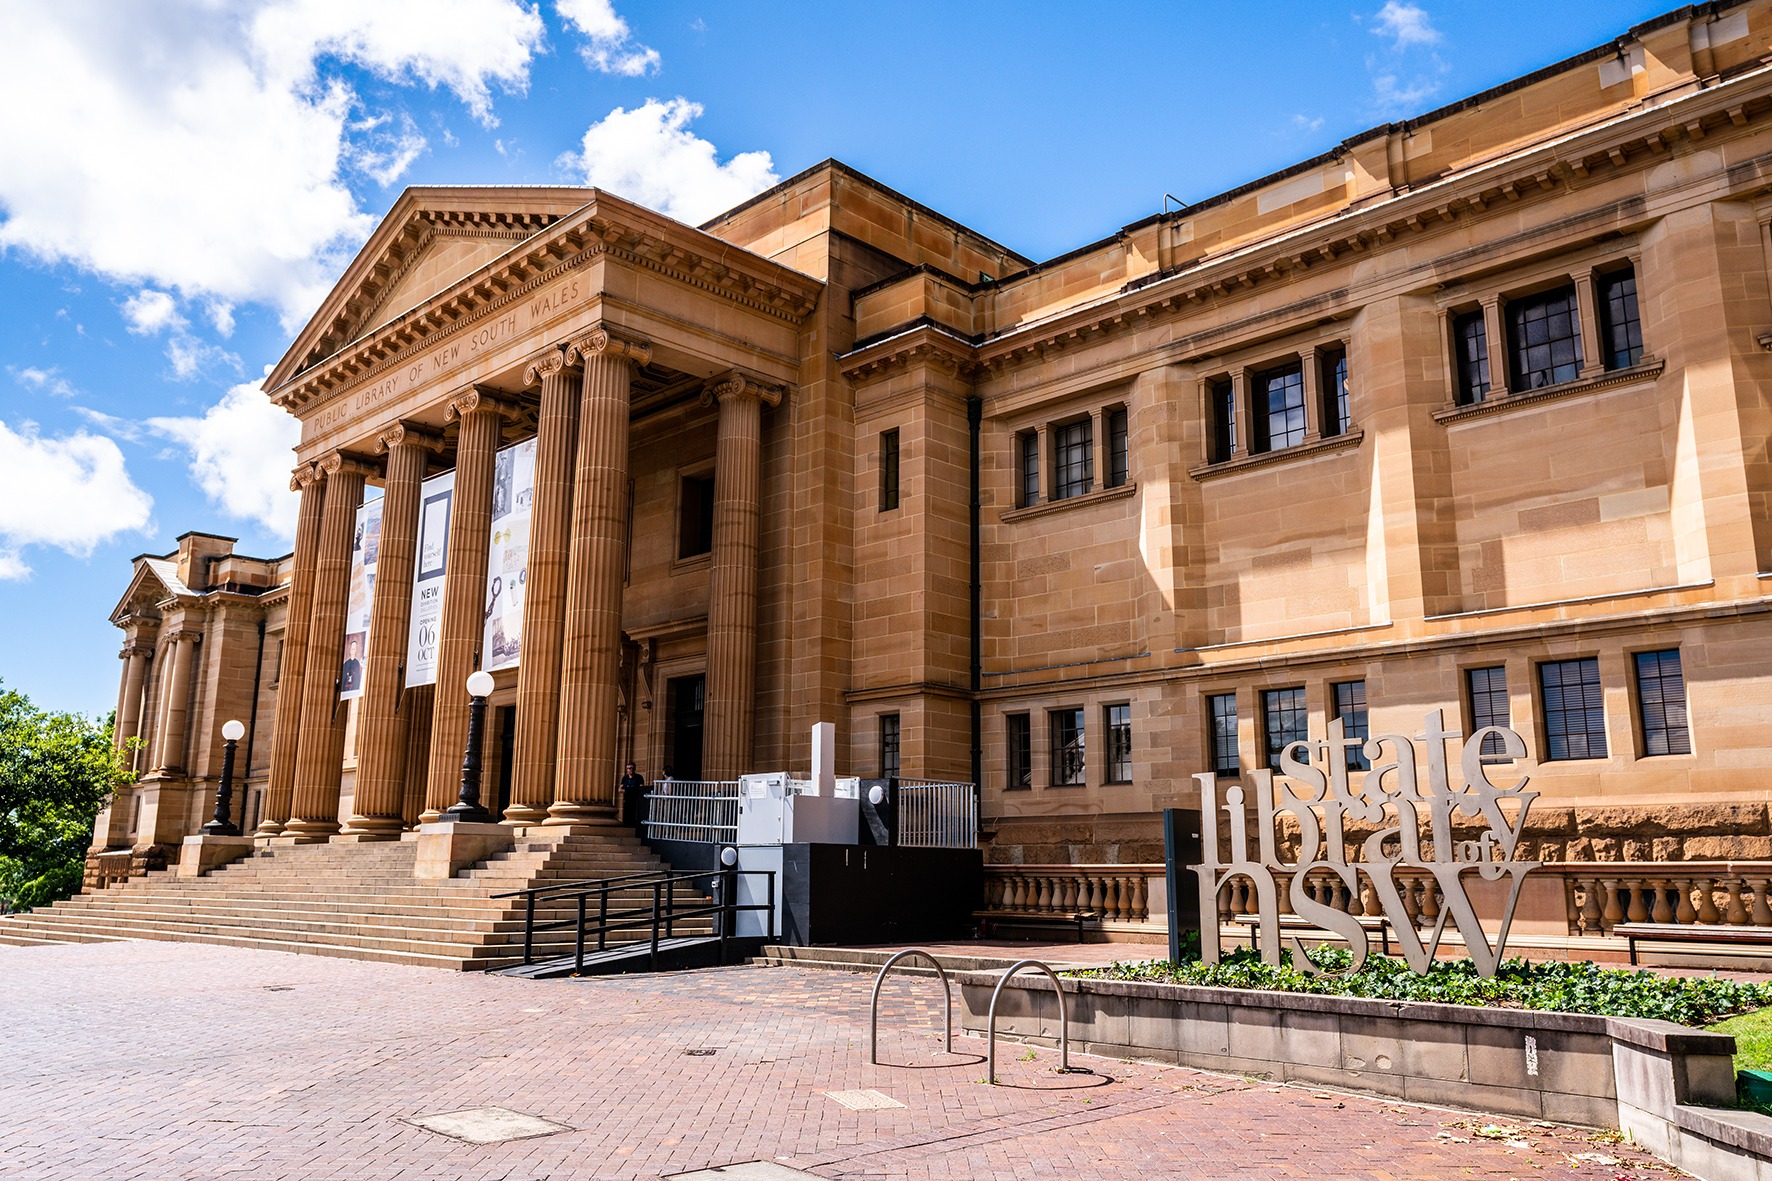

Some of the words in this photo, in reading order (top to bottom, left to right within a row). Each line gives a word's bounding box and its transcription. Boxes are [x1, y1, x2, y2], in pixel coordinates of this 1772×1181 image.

[313, 403, 348, 432] PUBLIC
[355, 375, 398, 411] LIBRARY
[409, 364, 424, 383] OF
[433, 343, 462, 369] NEW
[471, 314, 517, 351] SOUTH
[530, 281, 580, 320] WALES
[420, 586, 439, 600] NEW
[418, 623, 436, 648] 06
[419, 616, 437, 626] OPENING
[417, 646, 435, 662] OCT
[1279, 708, 1531, 803] state
[1191, 768, 1541, 881] library
[1457, 830, 1499, 864] of
[1185, 861, 1543, 979] nsw
